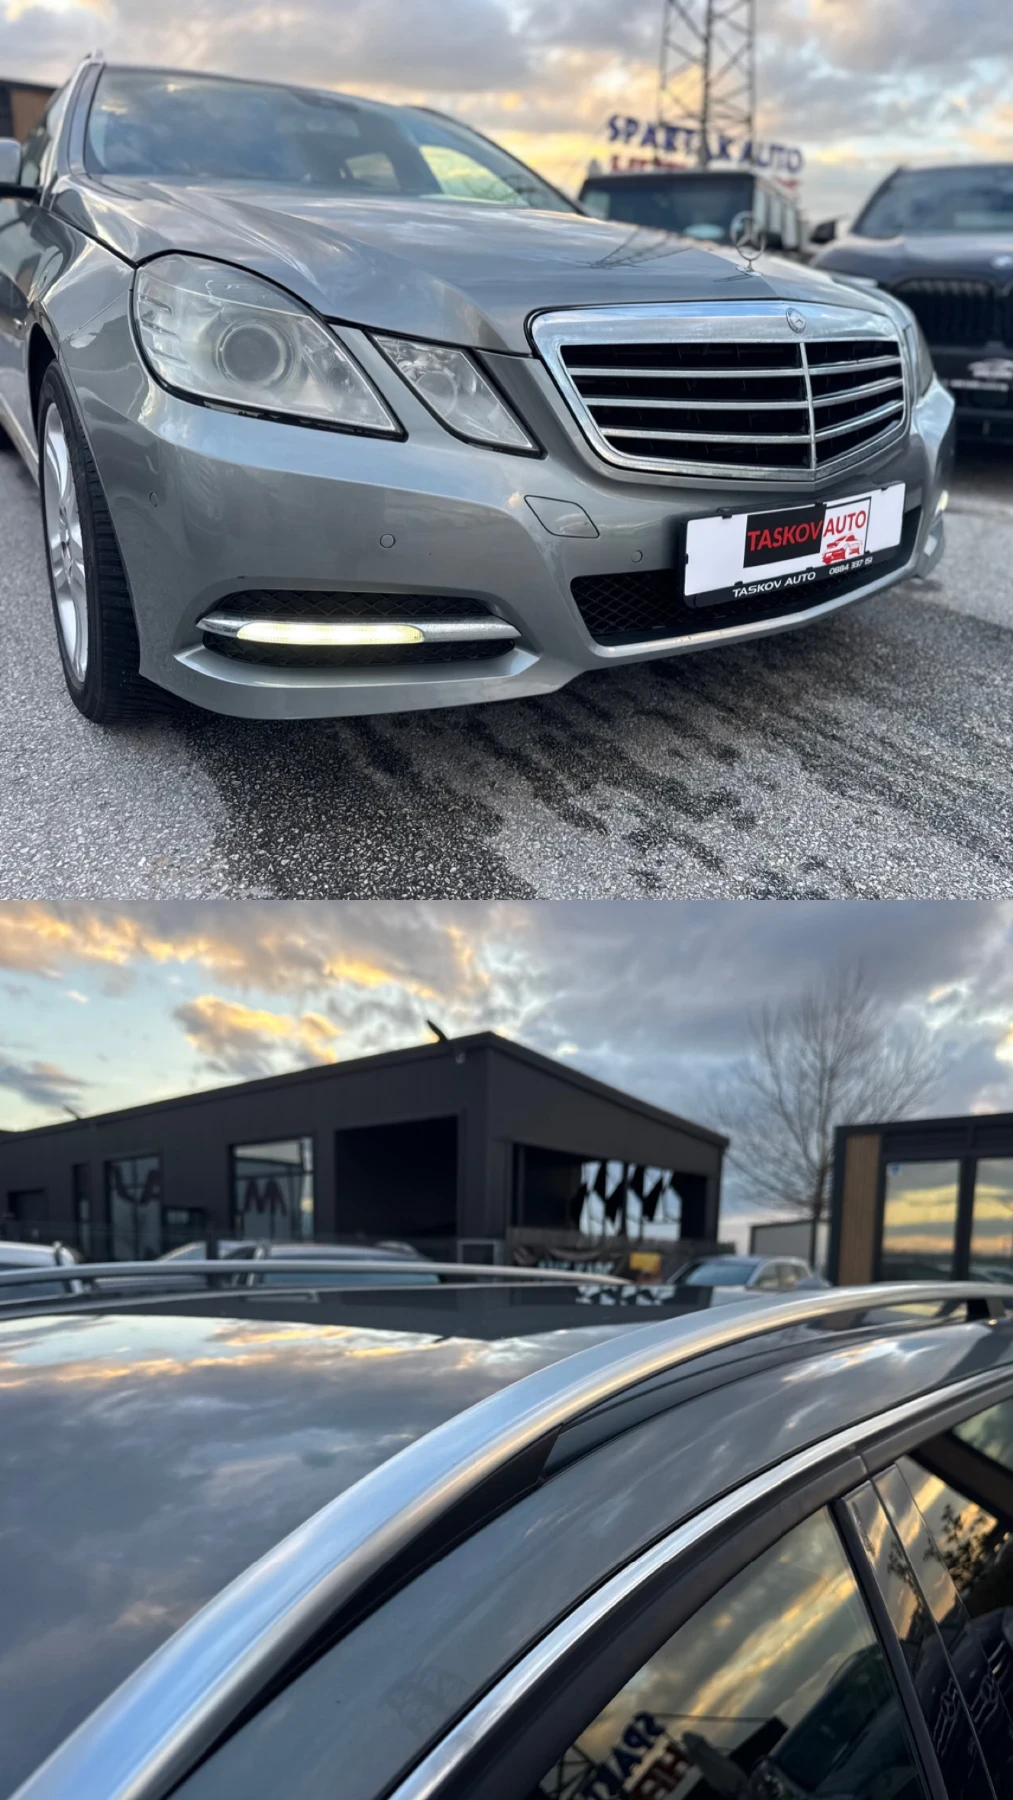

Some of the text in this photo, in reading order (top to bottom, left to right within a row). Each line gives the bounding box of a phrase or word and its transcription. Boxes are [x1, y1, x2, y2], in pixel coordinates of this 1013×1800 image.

[747, 510, 867, 551] TASKOV AUTO
[732, 579, 782, 598] TASKOV
[784, 571, 817, 587] AUTO
